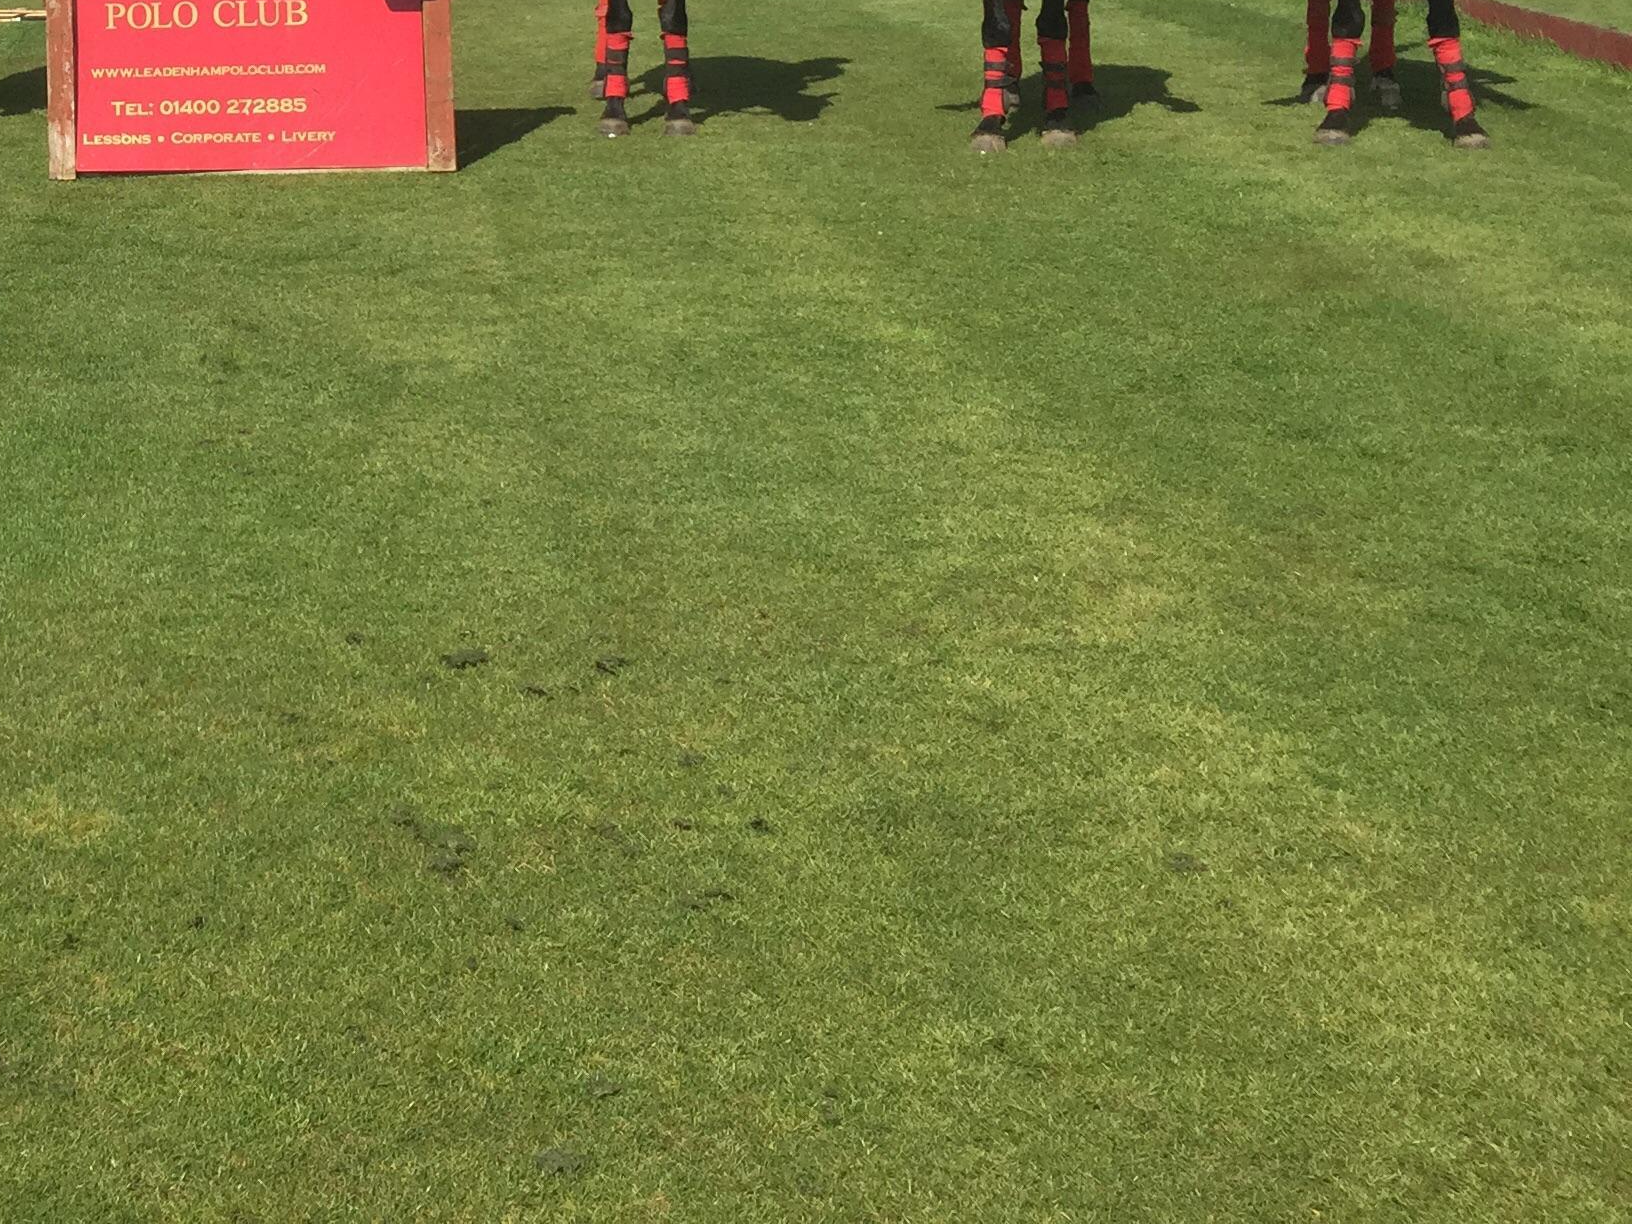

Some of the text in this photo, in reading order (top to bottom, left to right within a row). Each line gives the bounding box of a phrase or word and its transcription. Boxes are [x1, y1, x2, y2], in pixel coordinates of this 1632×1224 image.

[105, 0, 309, 30] POLO CLUB
[91, 64, 327, 79] WWW.LEADENHAMPOLOCLUB.COM
[159, 99, 221, 116] 01400
[226, 97, 308, 116] 272885
